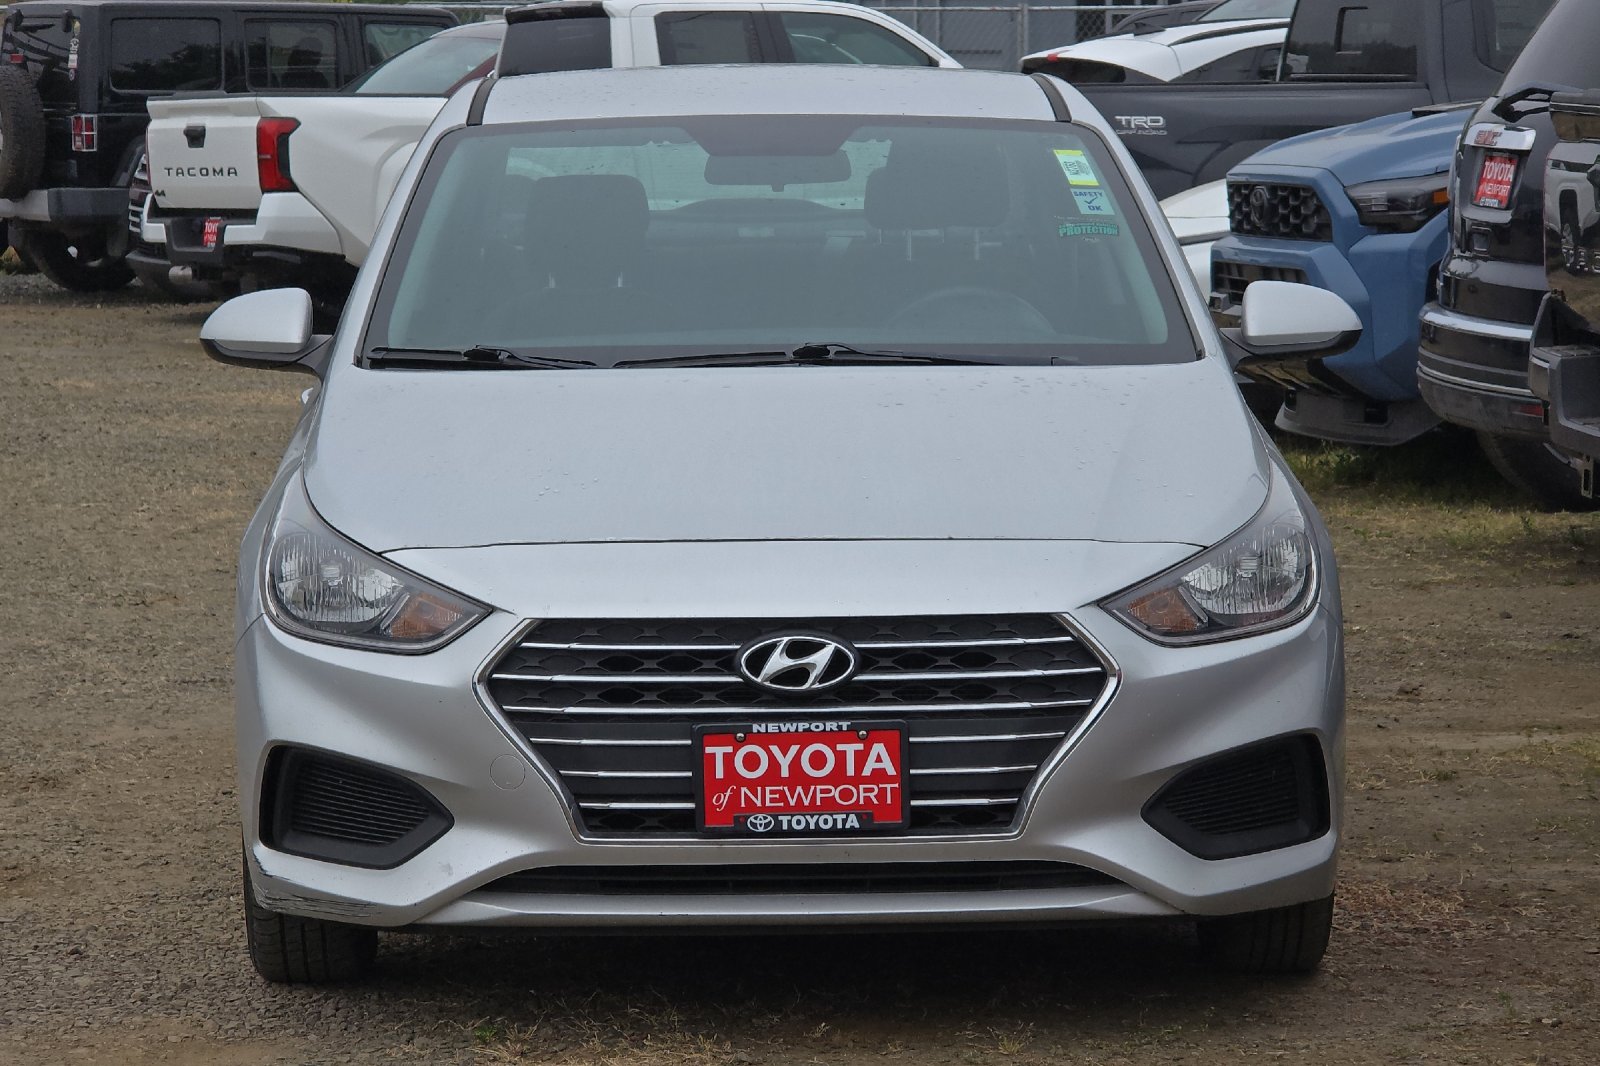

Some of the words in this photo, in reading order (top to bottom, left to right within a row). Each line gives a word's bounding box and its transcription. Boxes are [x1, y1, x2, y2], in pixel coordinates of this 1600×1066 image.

[1114, 115, 1164, 129] TRD
[163, 166, 238, 177] TACOMA
[1482, 161, 1515, 182] TOYOTA
[1059, 224, 1118, 237] PROTECTION
[752, 721, 851, 733] NEWPORT
[705, 743, 897, 779] TOYOTA
[712, 785, 737, 812] of
[740, 783, 899, 808] NEWPORT
[778, 814, 860, 831] TOYOTA
